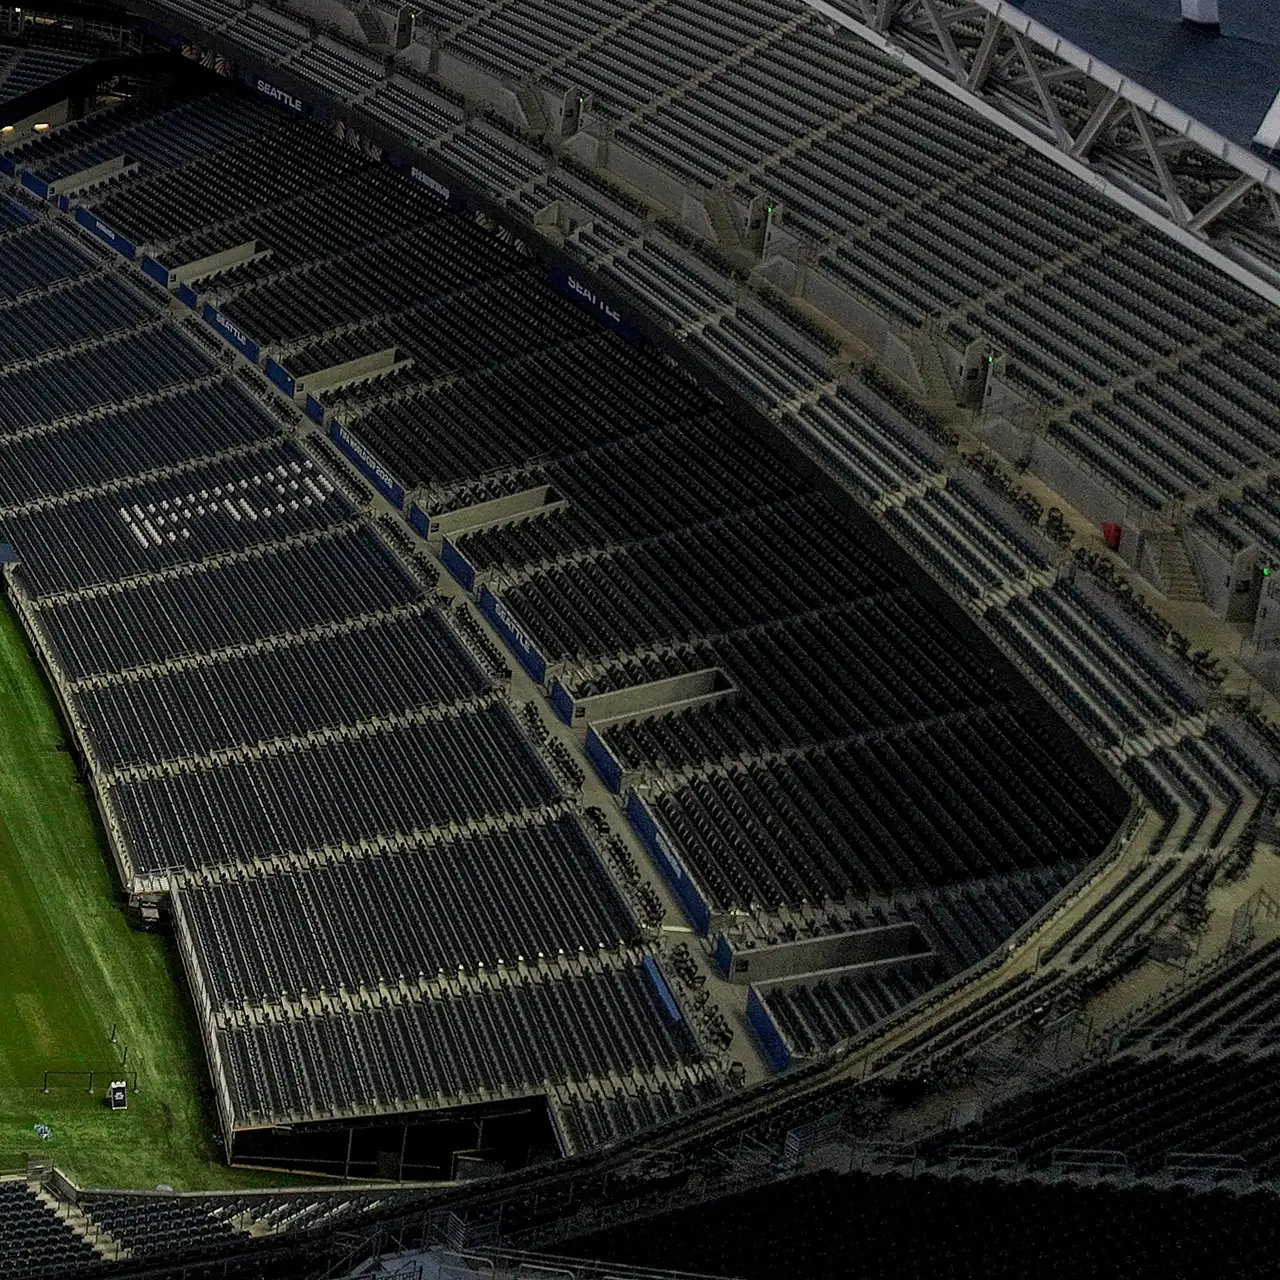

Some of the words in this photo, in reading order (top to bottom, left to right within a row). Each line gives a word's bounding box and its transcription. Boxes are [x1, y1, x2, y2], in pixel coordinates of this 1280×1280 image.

[257, 78, 302, 112] SEATTLE
[567, 275, 621, 323] SEATTLE
[215, 312, 247, 346] SEATTLE
[495, 604, 532, 653] SEATTLE
